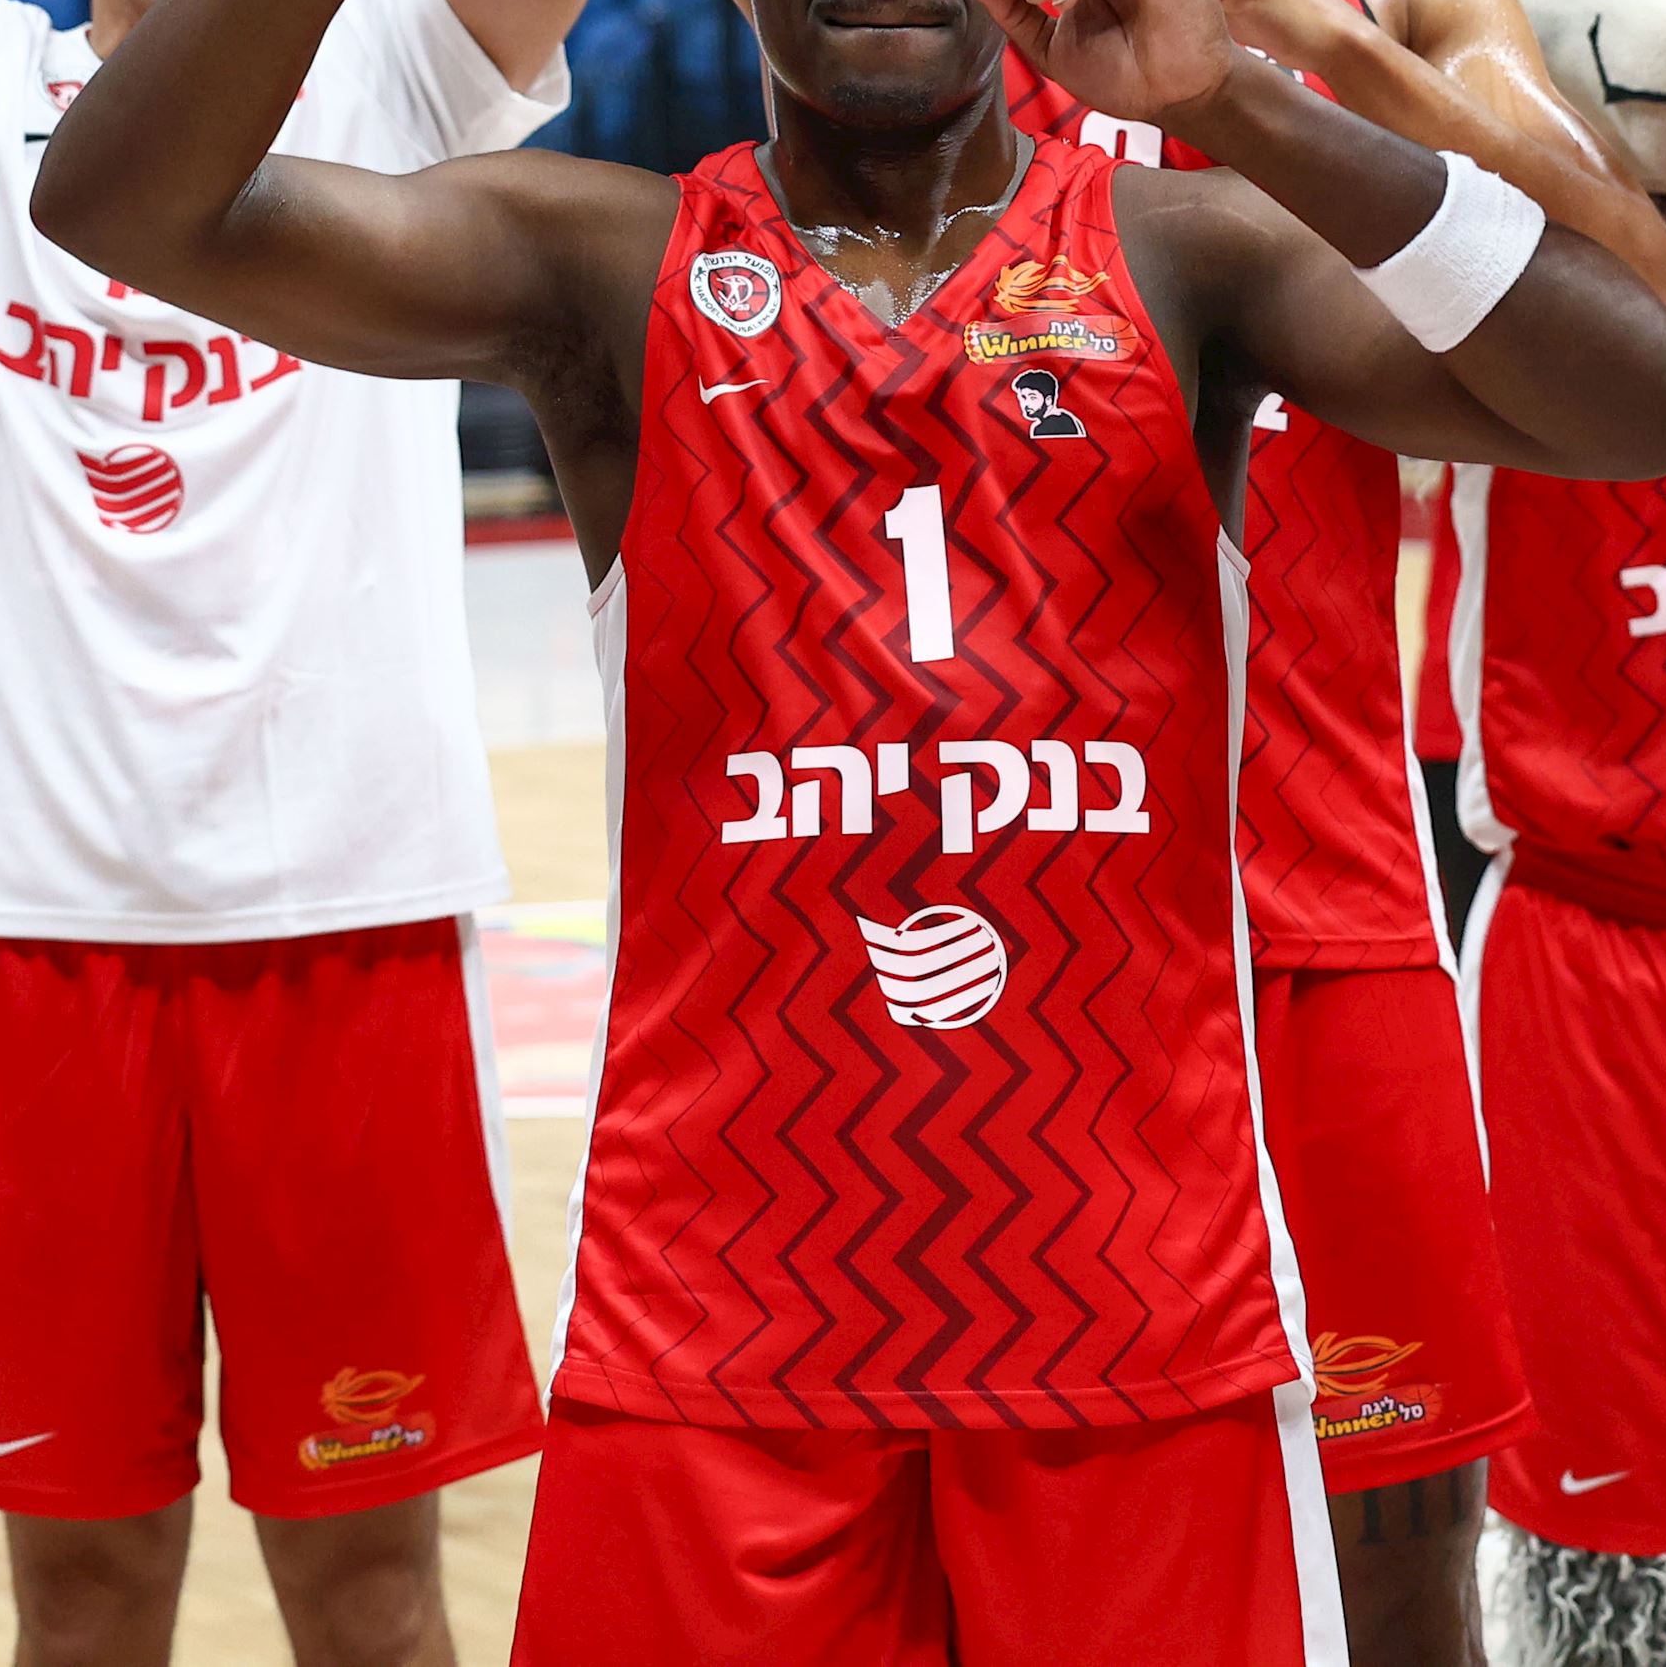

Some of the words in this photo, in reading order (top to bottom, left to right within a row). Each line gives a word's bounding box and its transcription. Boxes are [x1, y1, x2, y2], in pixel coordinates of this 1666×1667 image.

[1049, 319, 1085, 337] ליגת
[979, 333, 1088, 358] Winner
[1088, 333, 1117, 353] סל
[884, 484, 956, 663] 1
[721, 742, 910, 845] יהב
[938, 739, 1151, 854] בנק
[1361, 1395, 1395, 1417] ליגת
[1398, 1403, 1424, 1422] סל
